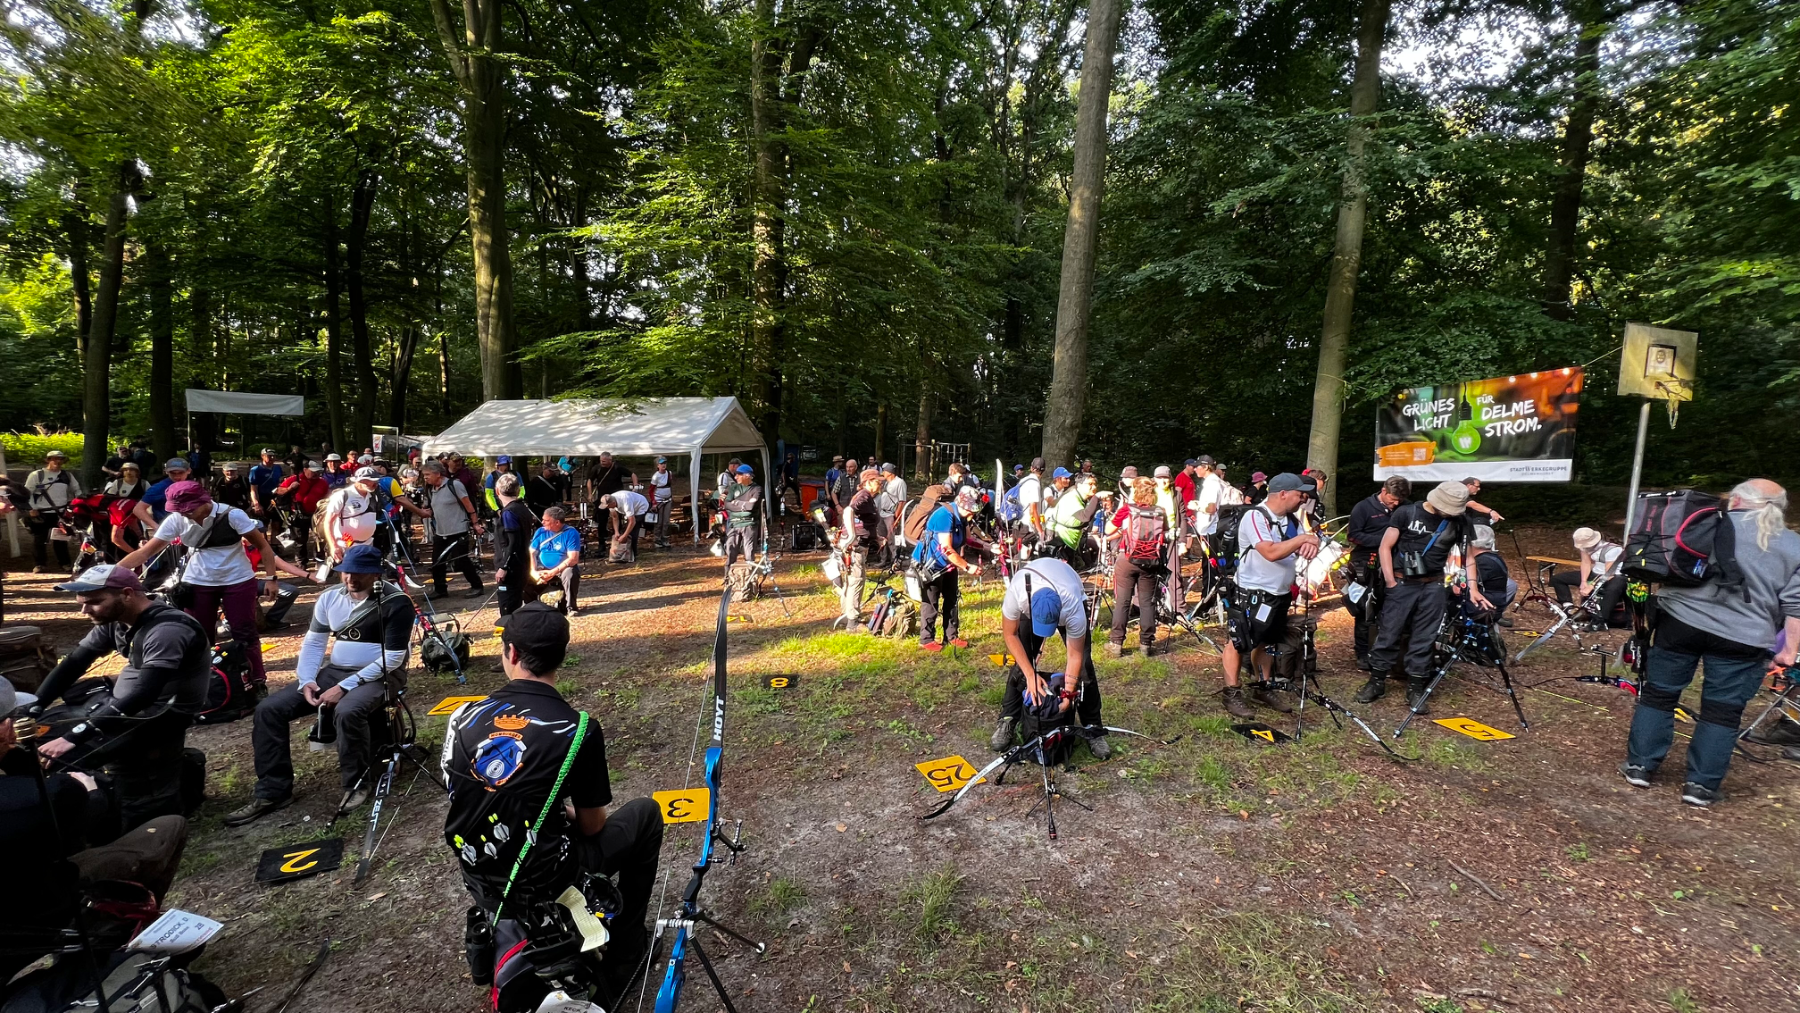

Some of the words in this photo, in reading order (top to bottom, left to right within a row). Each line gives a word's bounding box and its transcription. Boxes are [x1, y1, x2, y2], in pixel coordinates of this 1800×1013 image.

[1402, 397, 1456, 417] GRÜNES
[1476, 394, 1495, 406] FÜR
[1481, 399, 1535, 421] DELME
[1414, 413, 1452, 432] LICHT
[1485, 416, 1543, 438] STROM.
[770, 677, 789, 688] 8
[713, 695, 724, 741] HOYT
[1250, 729, 1275, 743] 4
[1460, 724, 1495, 737] 5
[926, 762, 978, 788] 25
[667, 798, 694, 818] 3
[280, 847, 321, 873] 2
